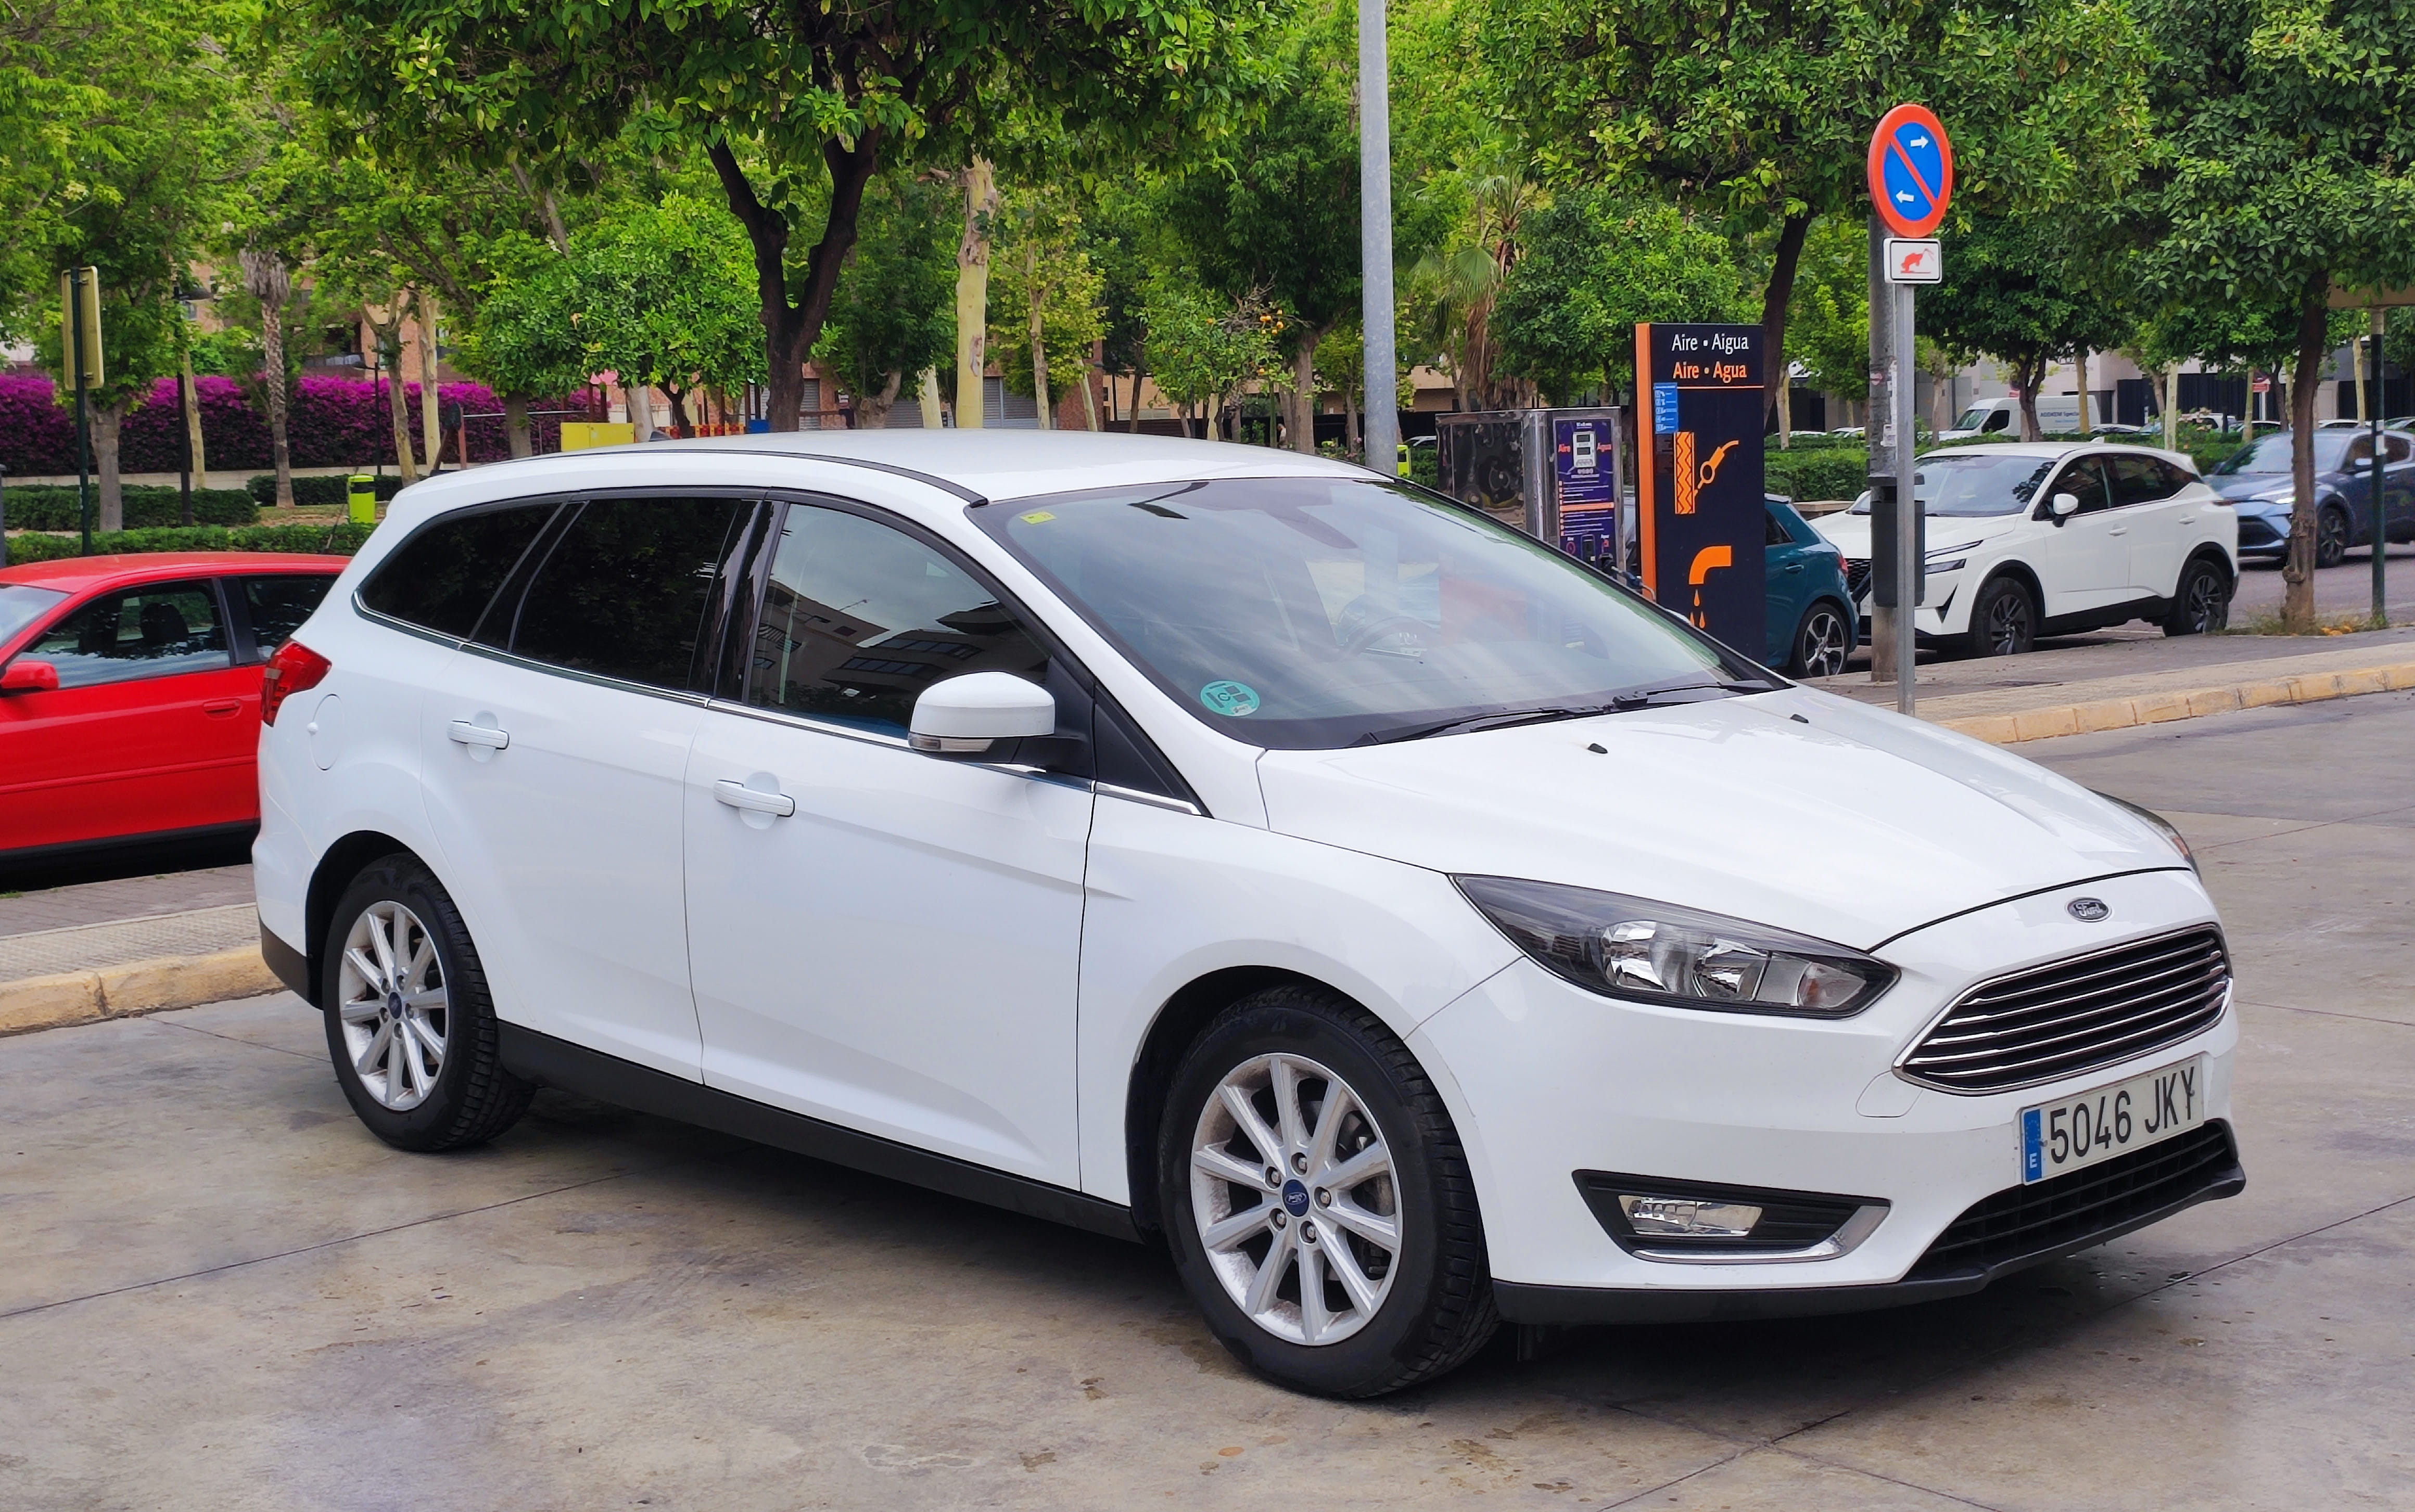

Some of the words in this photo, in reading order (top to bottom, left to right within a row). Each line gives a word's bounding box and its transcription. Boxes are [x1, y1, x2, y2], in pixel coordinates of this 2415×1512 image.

[1672, 334, 1698, 351] Aire
[1711, 333, 1749, 355] Aigua
[1673, 361, 1699, 379] Aire
[1713, 361, 1747, 383] Agua
[2050, 1090, 2131, 1163] 5046
[2144, 1066, 2194, 1133] JKY
[2029, 1152, 2038, 1168] E
